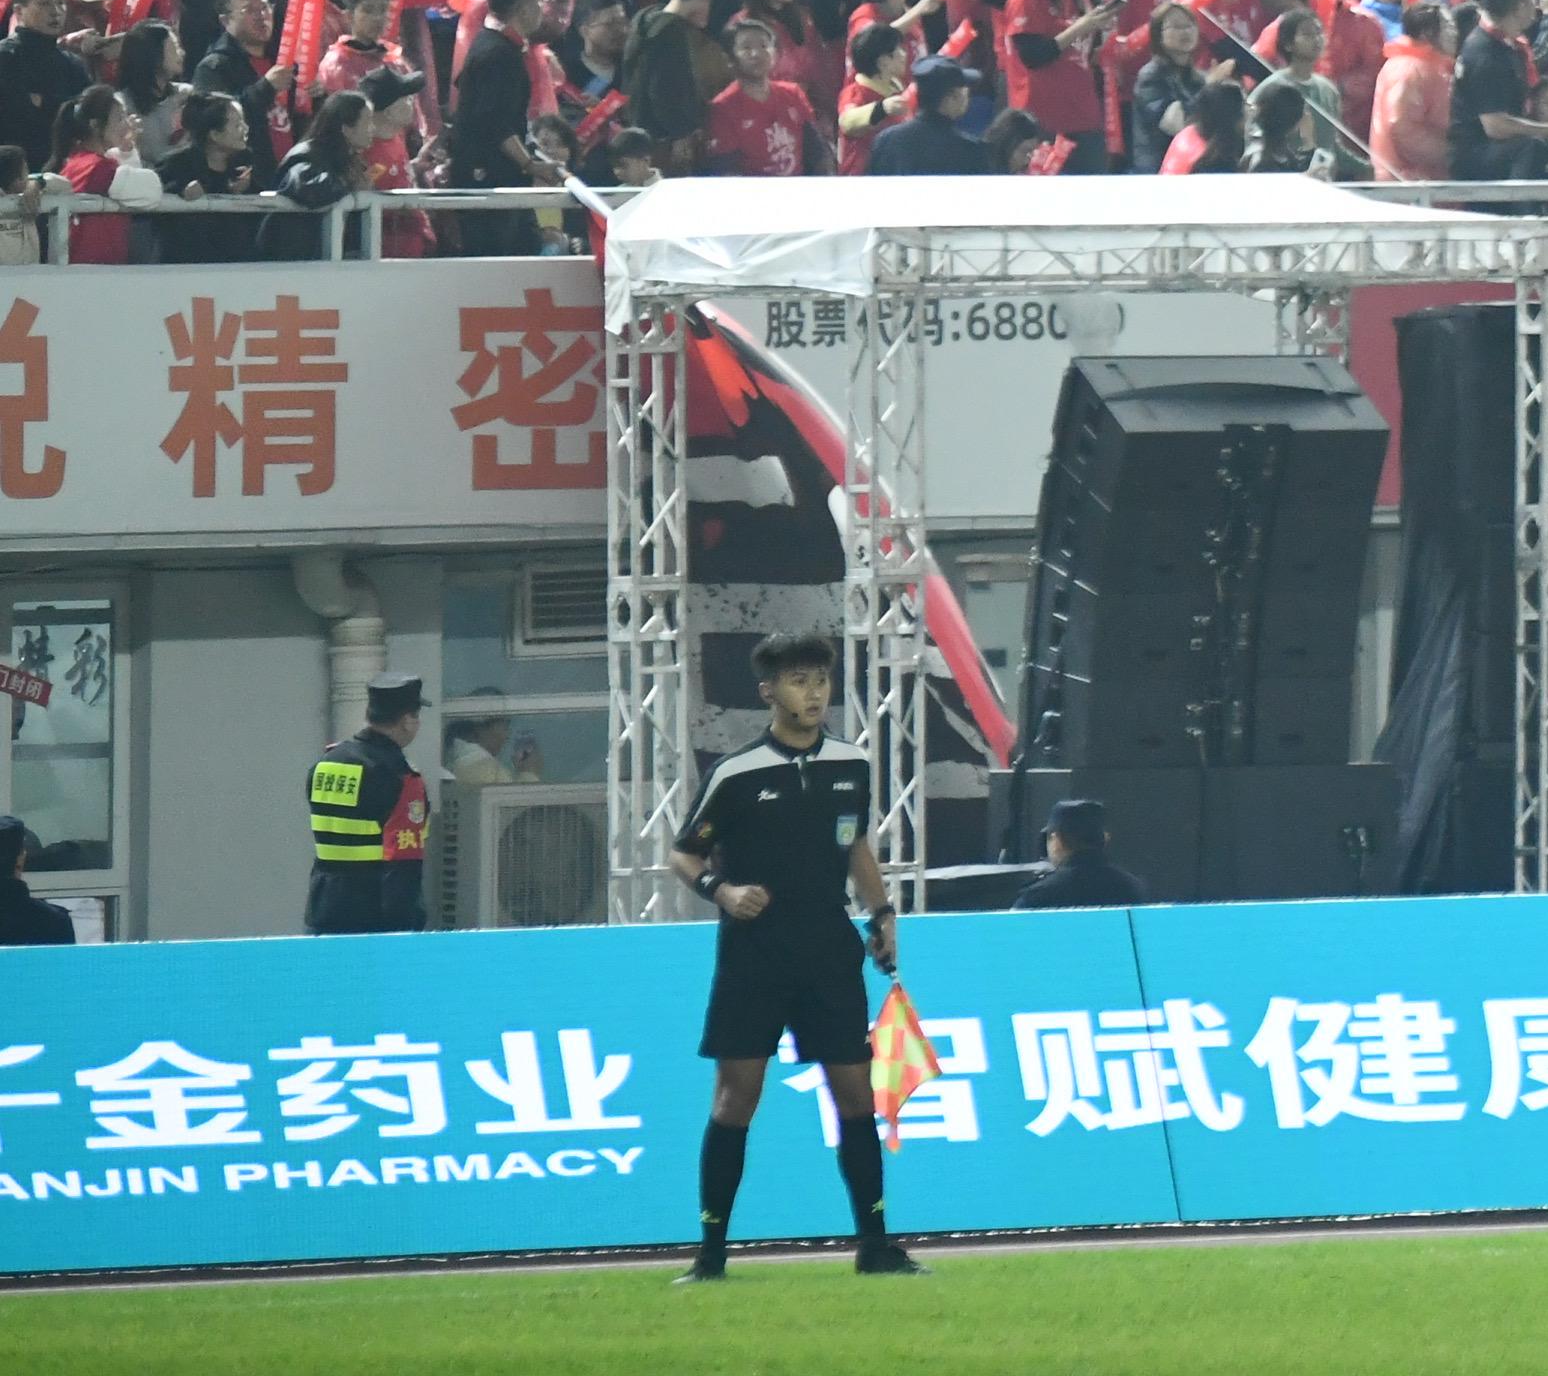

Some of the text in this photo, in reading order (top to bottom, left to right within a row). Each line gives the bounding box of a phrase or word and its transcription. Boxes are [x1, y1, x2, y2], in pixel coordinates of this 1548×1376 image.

[313, 771, 359, 796] 国投保安
[224, 1146, 646, 1192] PHARMACY
